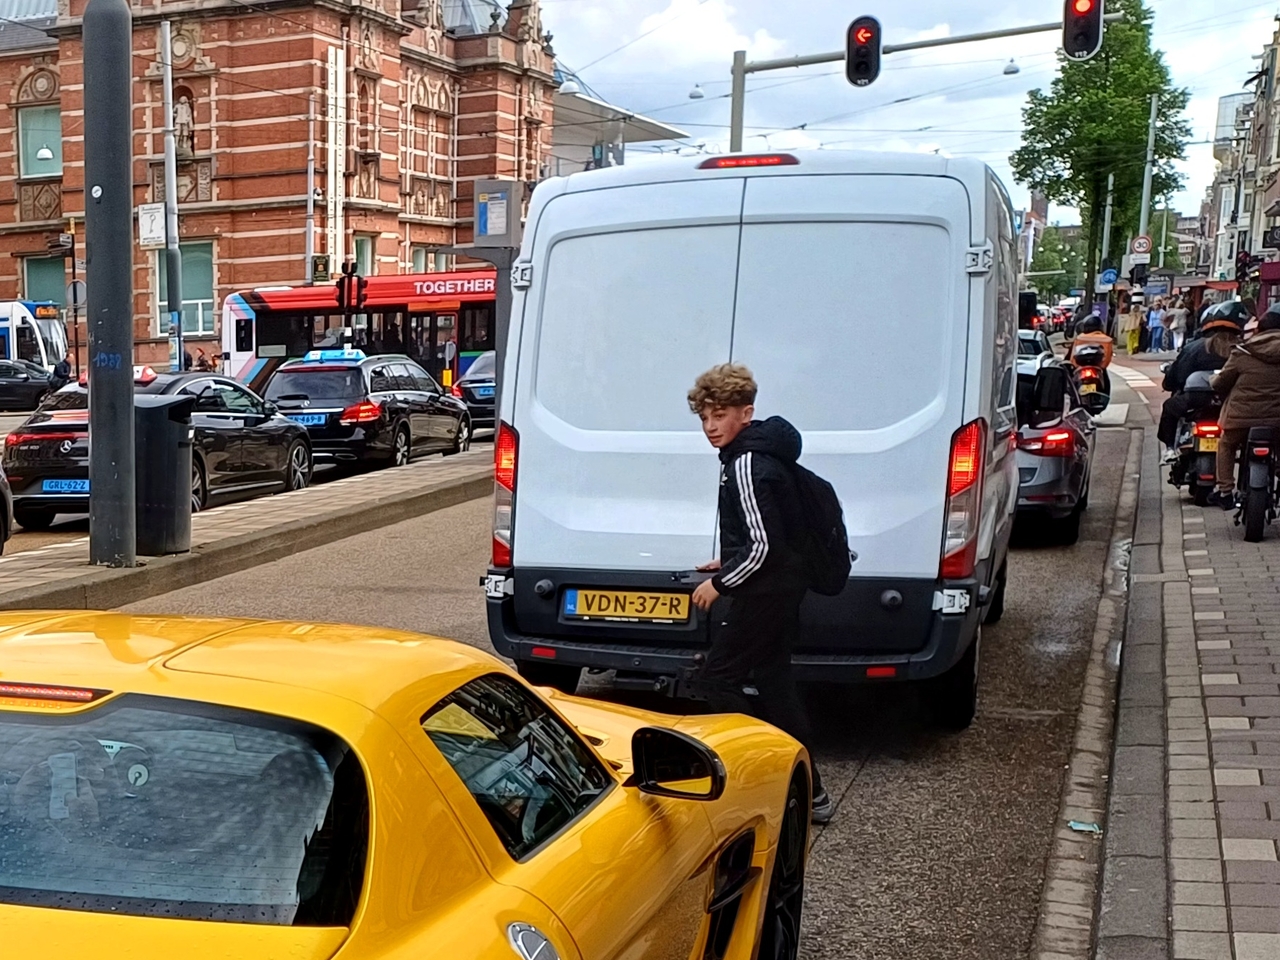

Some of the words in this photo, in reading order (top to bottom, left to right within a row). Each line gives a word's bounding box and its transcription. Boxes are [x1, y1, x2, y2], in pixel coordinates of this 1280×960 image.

[1136, 241, 1148, 249] 30
[414, 279, 495, 294] TOGETHER
[584, 594, 682, 615] VDN-37-R
